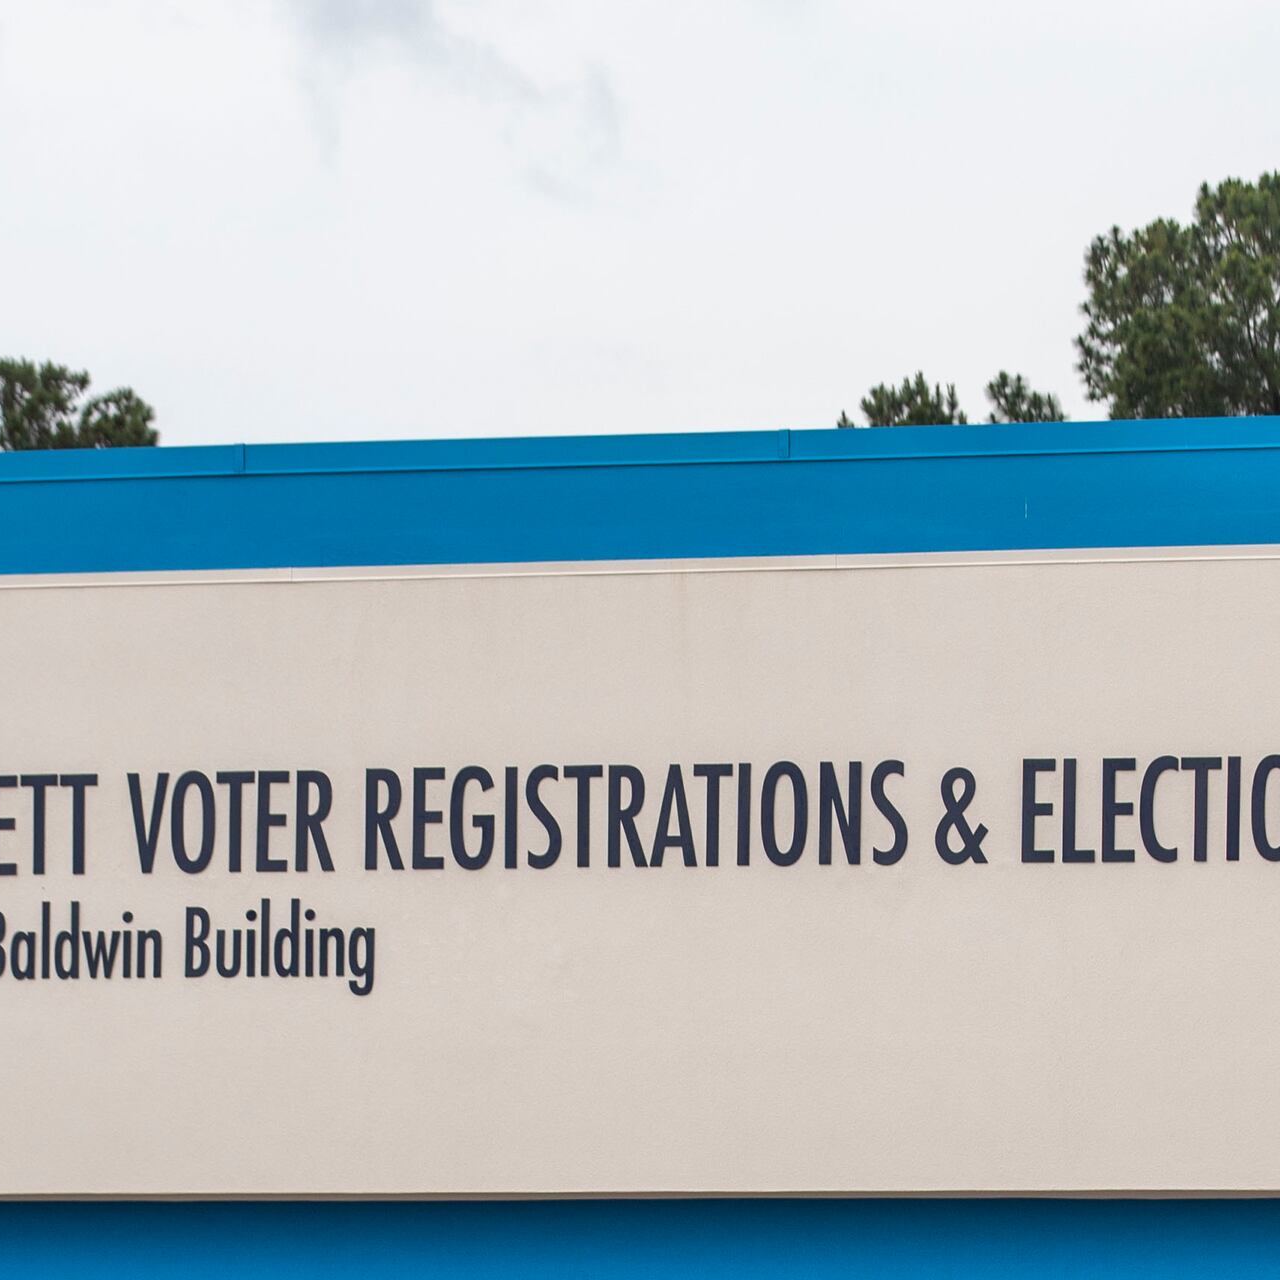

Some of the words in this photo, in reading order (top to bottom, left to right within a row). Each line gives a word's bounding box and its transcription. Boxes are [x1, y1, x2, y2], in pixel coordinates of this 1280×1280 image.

[127, 770, 335, 874] VOTER
[365, 760, 909, 871] REGISTRATIONS
[934, 767, 989, 865] &
[184, 898, 376, 996] Building
